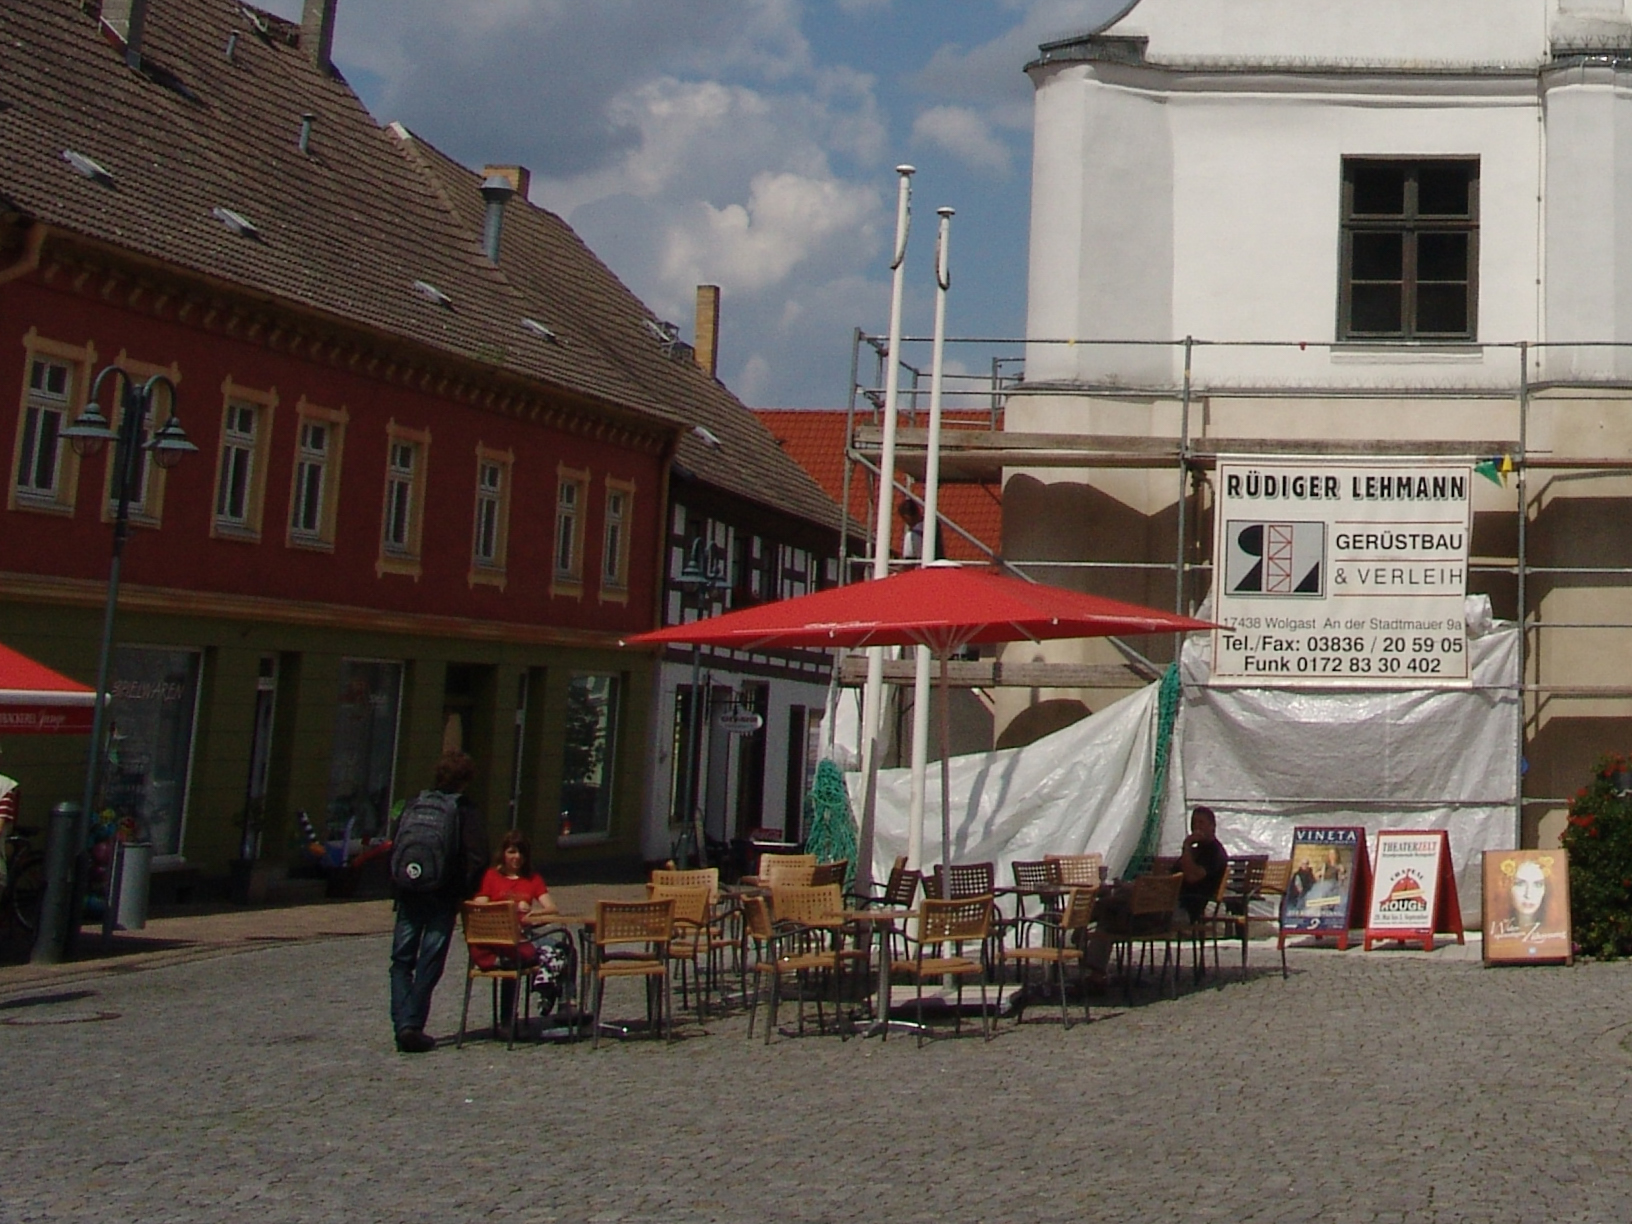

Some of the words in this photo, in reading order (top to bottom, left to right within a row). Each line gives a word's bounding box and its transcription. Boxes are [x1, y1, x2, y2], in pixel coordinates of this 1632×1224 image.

[1227, 470, 1339, 499] RÜDIGER
[1352, 475, 1466, 500] LEHMANN
[1335, 530, 1463, 551] GERÜSTBAU
[1334, 568, 1347, 585] &
[1357, 568, 1463, 585] VERLEIH
[1223, 617, 1262, 630] 17438
[1265, 617, 1316, 631] Wolgast
[1323, 618, 1341, 630] An
[1345, 618, 1366, 630] der
[1369, 618, 1444, 631] Stadtmauer
[1446, 619, 1462, 631] 9a
[1222, 635, 1301, 652] Tel./Fax:
[1307, 637, 1364, 652] 03836
[1383, 637, 1405, 653] 20
[1411, 637, 1435, 653] 59
[1440, 637, 1463, 653] 05
[1244, 656, 1290, 672] Funk
[1297, 657, 1343, 673] 0172
[1349, 657, 1371, 673] 83
[1378, 658, 1401, 673] 30
[1407, 658, 1441, 673] 402
[1296, 830, 1356, 841] VINETA
[1383, 841, 1437, 852] THEATERZELT
